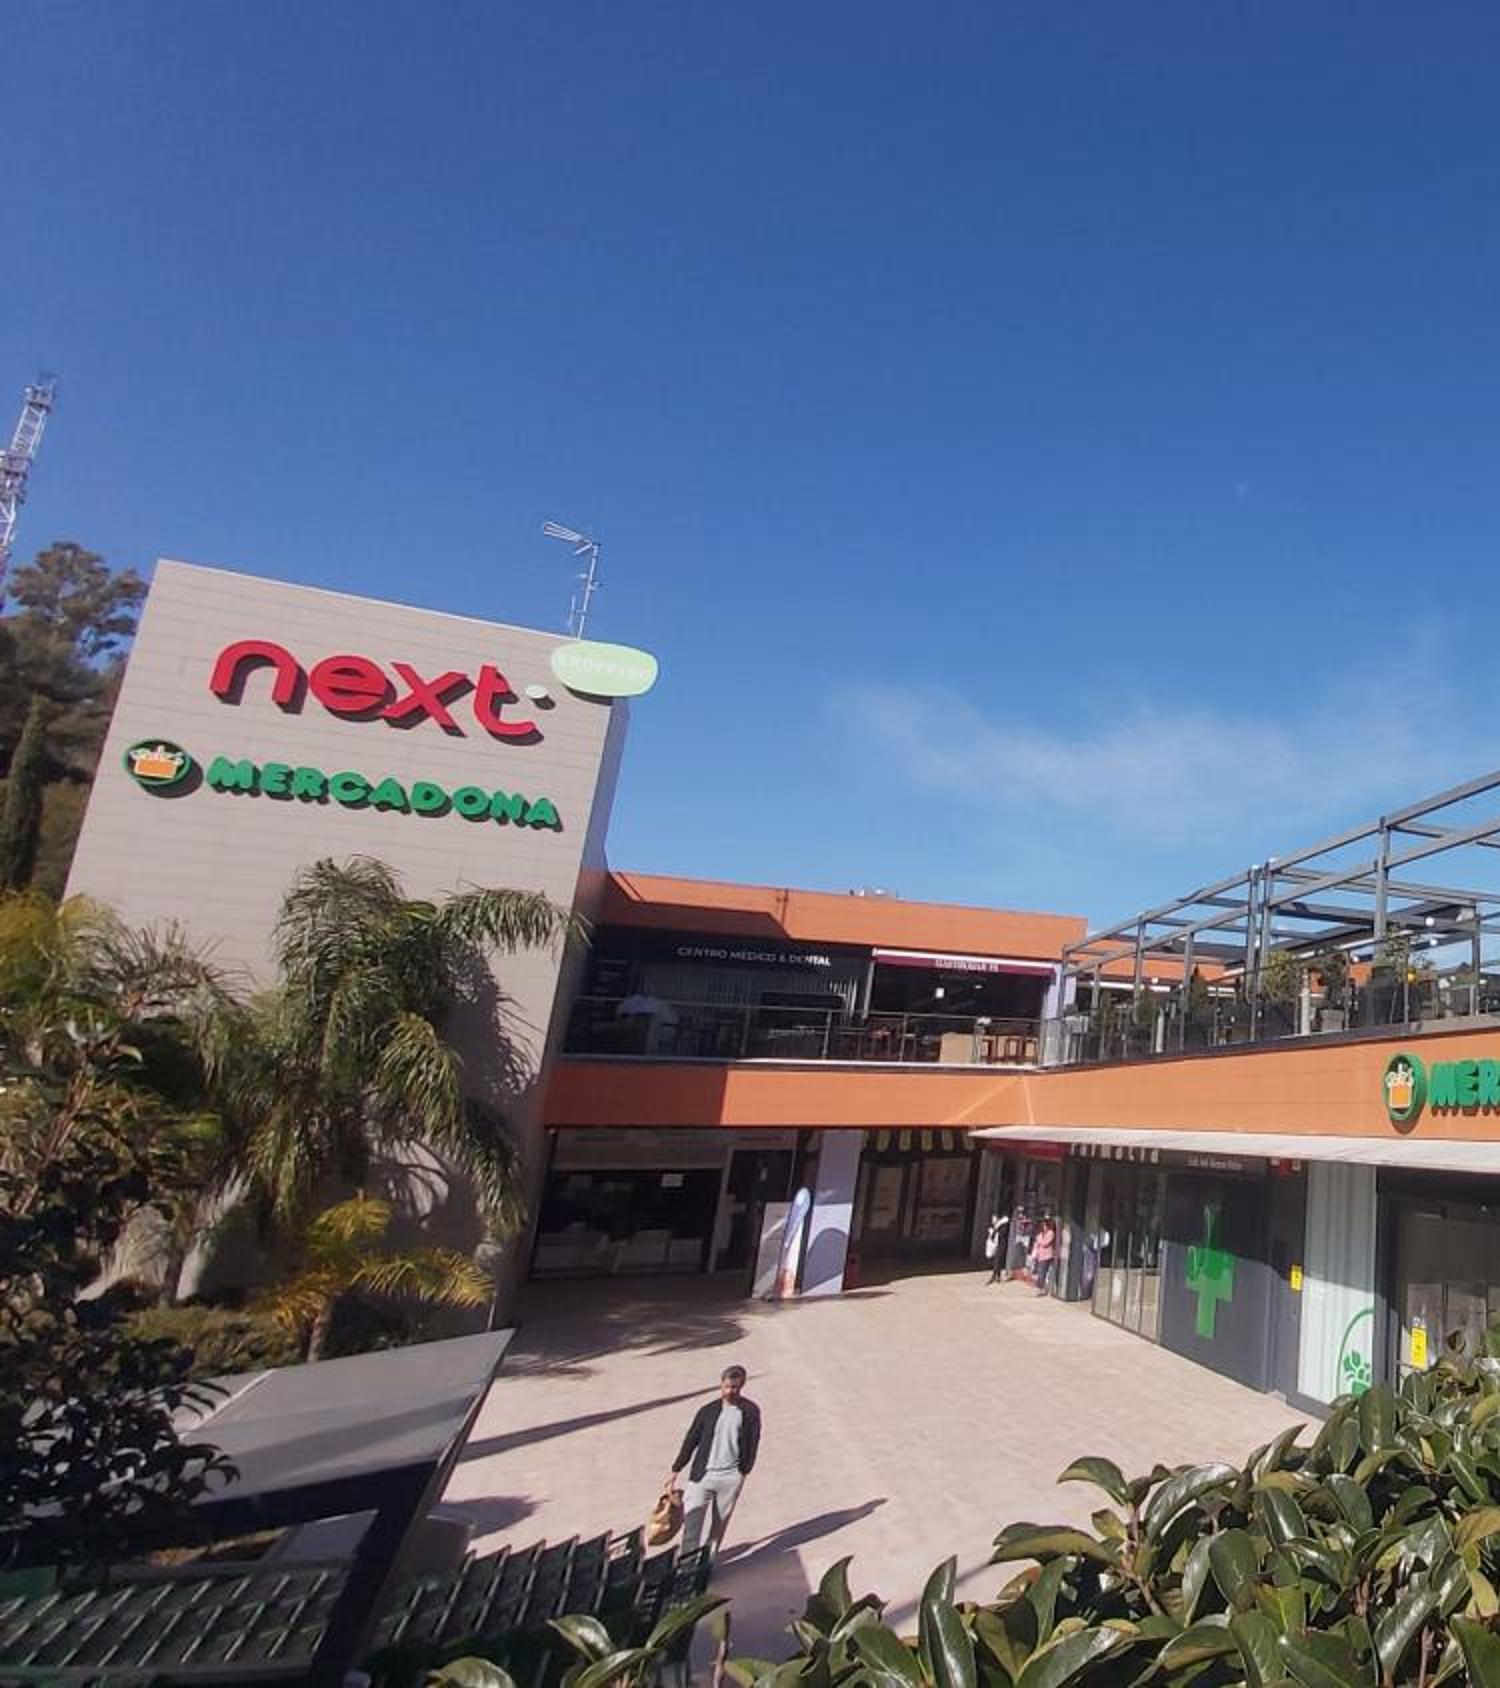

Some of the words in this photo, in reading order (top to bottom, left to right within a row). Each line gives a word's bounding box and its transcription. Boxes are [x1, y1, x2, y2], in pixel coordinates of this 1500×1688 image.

[209, 639, 541, 740] next
[206, 757, 560, 829] MERCADONA
[677, 946, 727, 959] CENTRO
[779, 952, 787, 963] &
[789, 954, 832, 967] DENTAL
